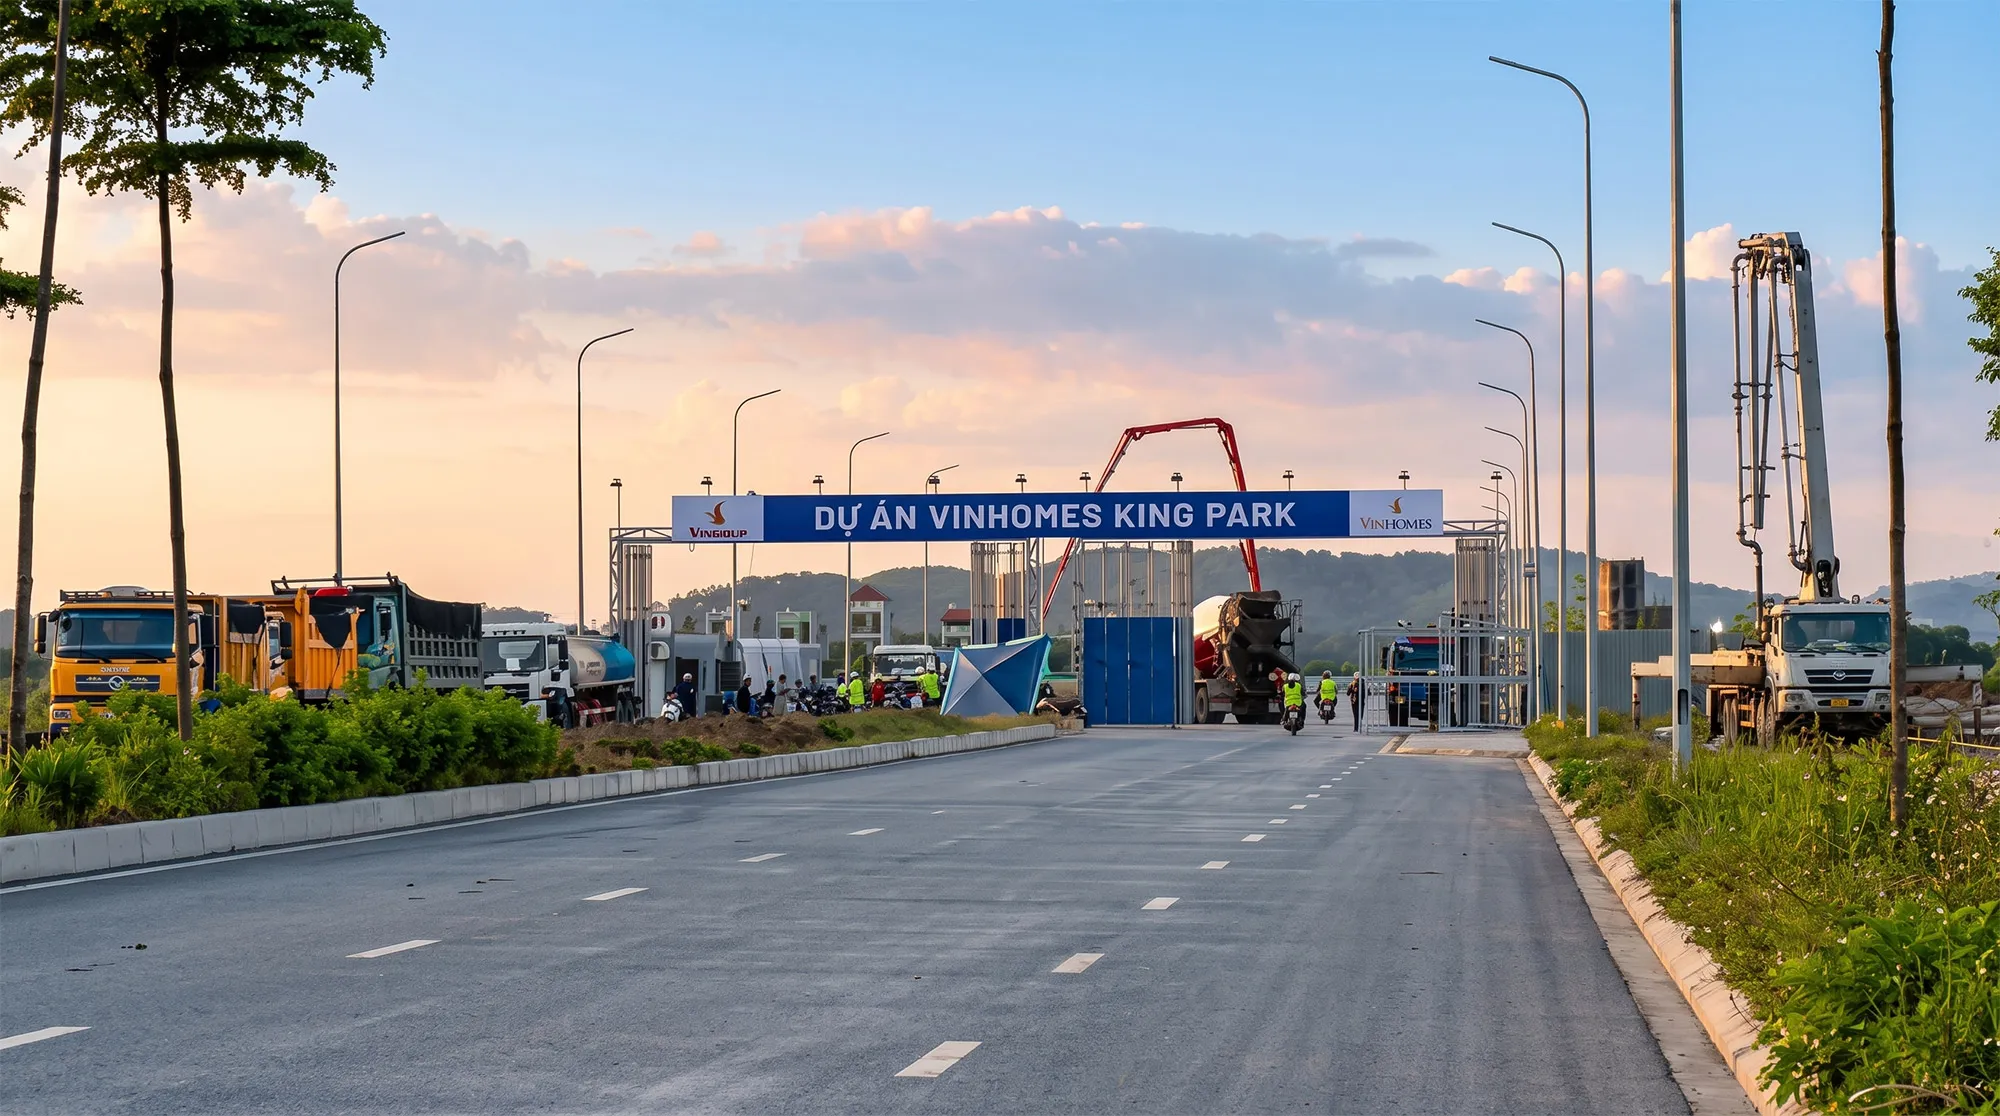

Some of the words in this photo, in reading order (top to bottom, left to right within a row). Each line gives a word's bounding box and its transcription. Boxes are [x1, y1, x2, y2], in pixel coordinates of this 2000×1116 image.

[815, 503, 863, 537] DỰ
[870, 500, 916, 530] ÁN
[929, 503, 1102, 529] VINHOMES
[1114, 503, 1194, 528] KING
[1206, 502, 1296, 527] PARK
